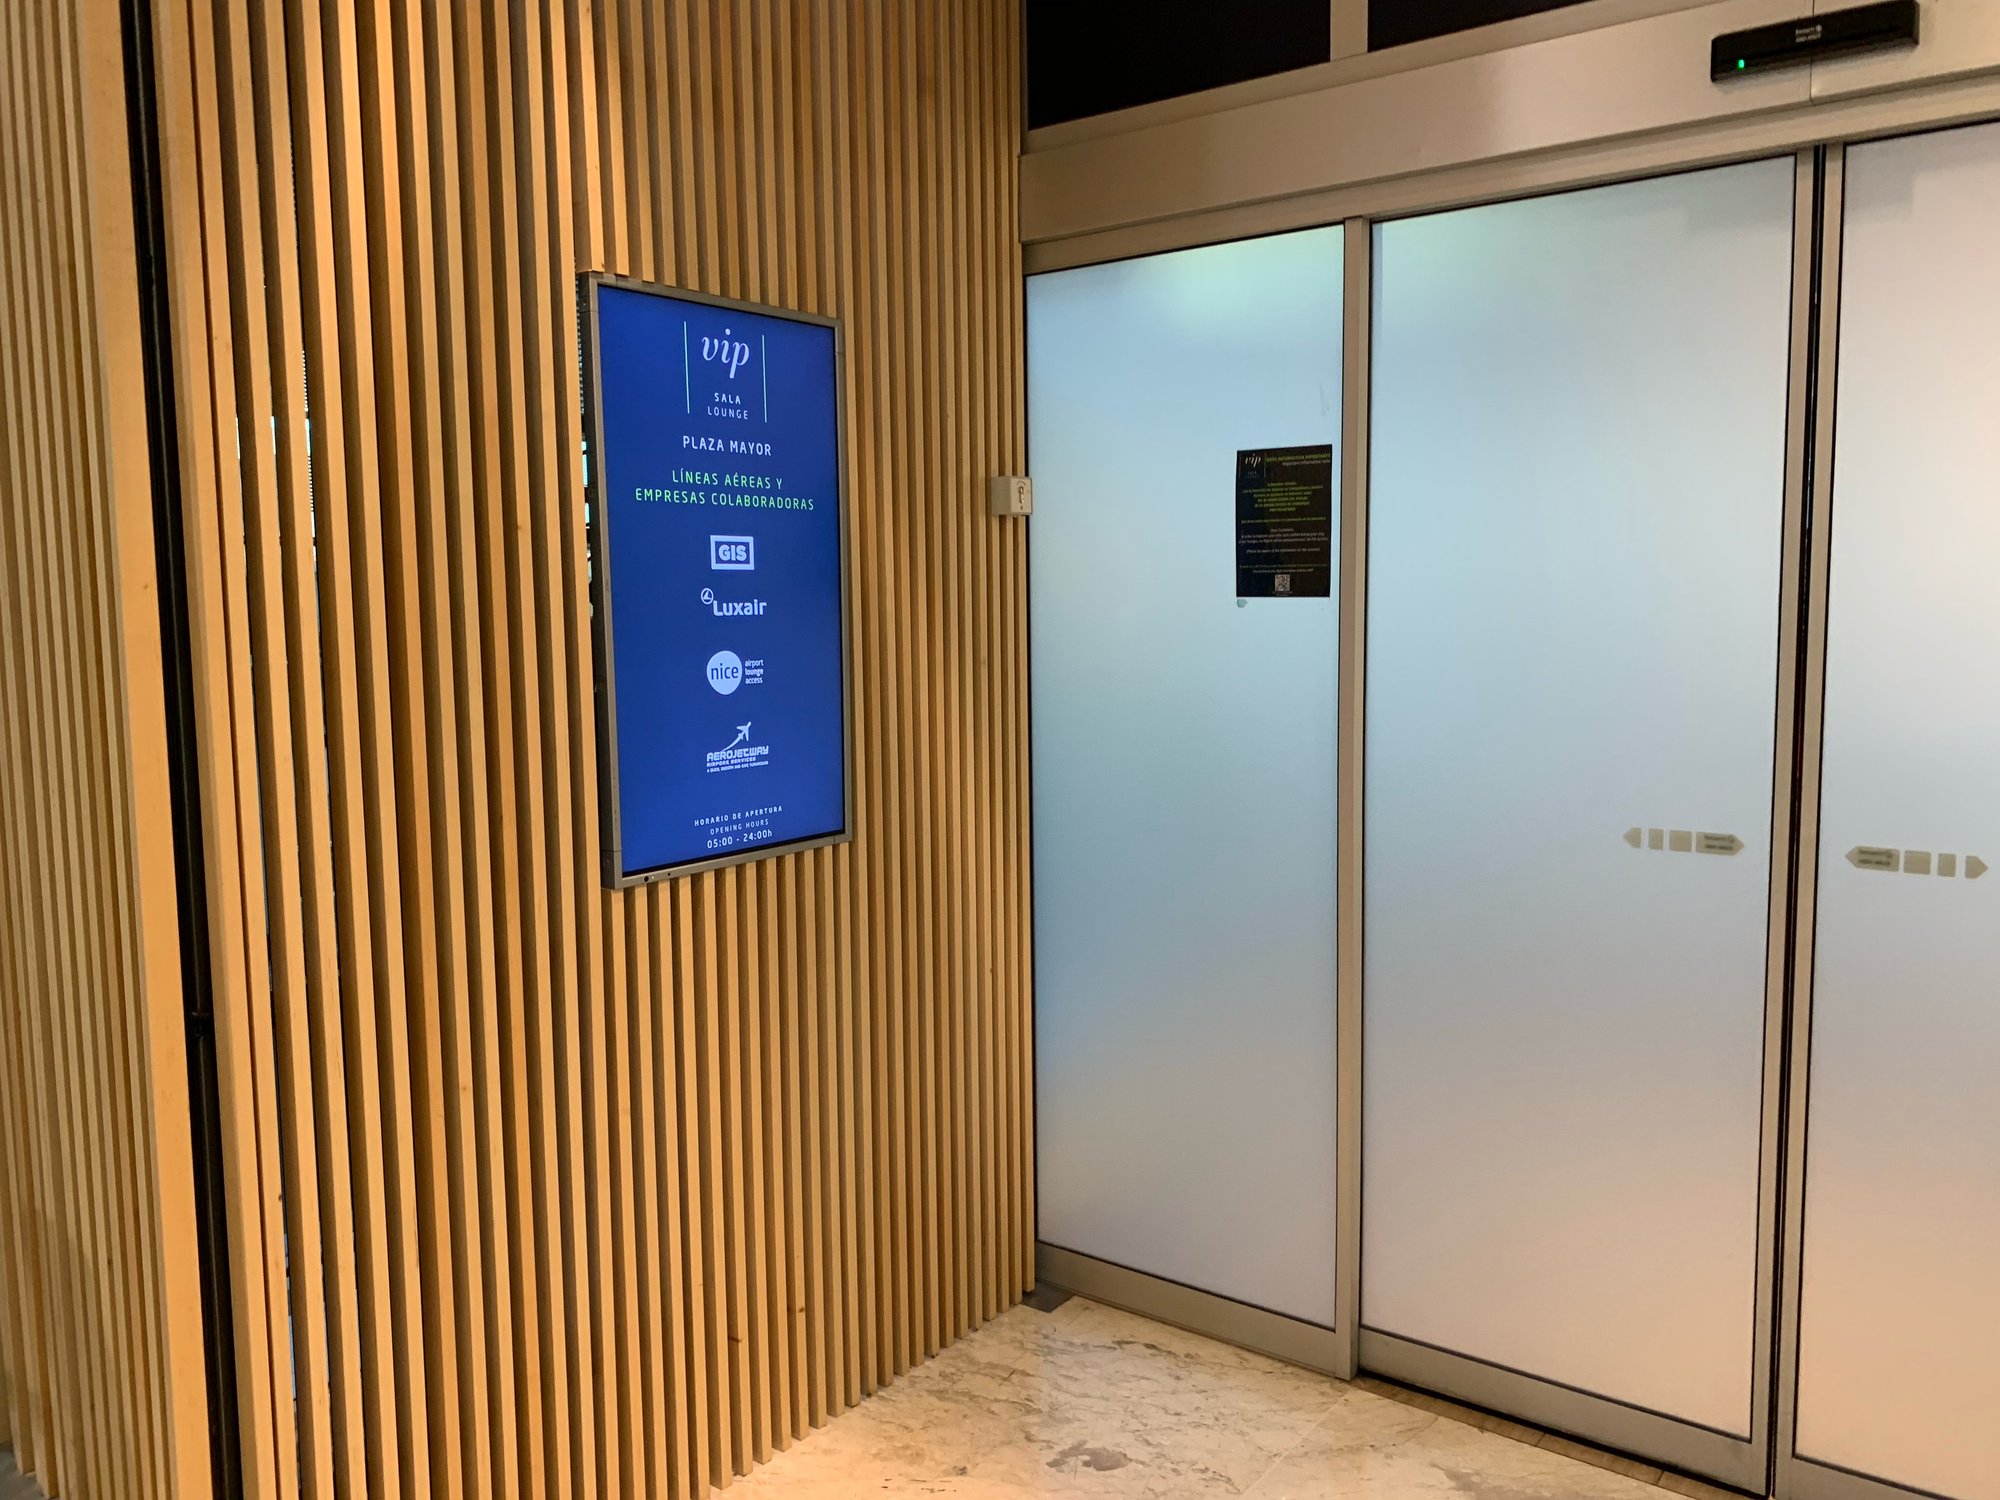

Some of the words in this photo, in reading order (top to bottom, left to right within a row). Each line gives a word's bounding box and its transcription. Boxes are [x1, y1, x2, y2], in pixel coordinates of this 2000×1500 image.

[701, 328, 750, 379] vip
[714, 393, 741, 404] SALA
[707, 406, 749, 420] LOUNGE
[683, 435, 724, 452] PLAZA
[730, 440, 772, 456] MAYOR
[672, 468, 718, 485] LÍNEAS
[724, 472, 771, 489] AÉREAS
[776, 478, 782, 490] Y
[635, 488, 706, 505] EMPRESAS
[711, 492, 814, 511] COLABORADORAS
[718, 544, 747, 561] GIS
[713, 599, 767, 616] Luxair
[711, 663, 739, 680] nice
[745, 659, 764, 668] airport
[745, 667, 764, 677] lounge
[745, 676, 763, 684] access
[707, 745, 769, 762] AEROJETWAY
[731, 757, 757, 765] SERVICES
[694, 814, 729, 827] HORARIO
[745, 805, 783, 818] APERTURA
[710, 823, 743, 835] OPENING
[745, 818, 769, 829] HOURS
[707, 836, 733, 849] 05:00
[743, 829, 773, 842] 24:00h
